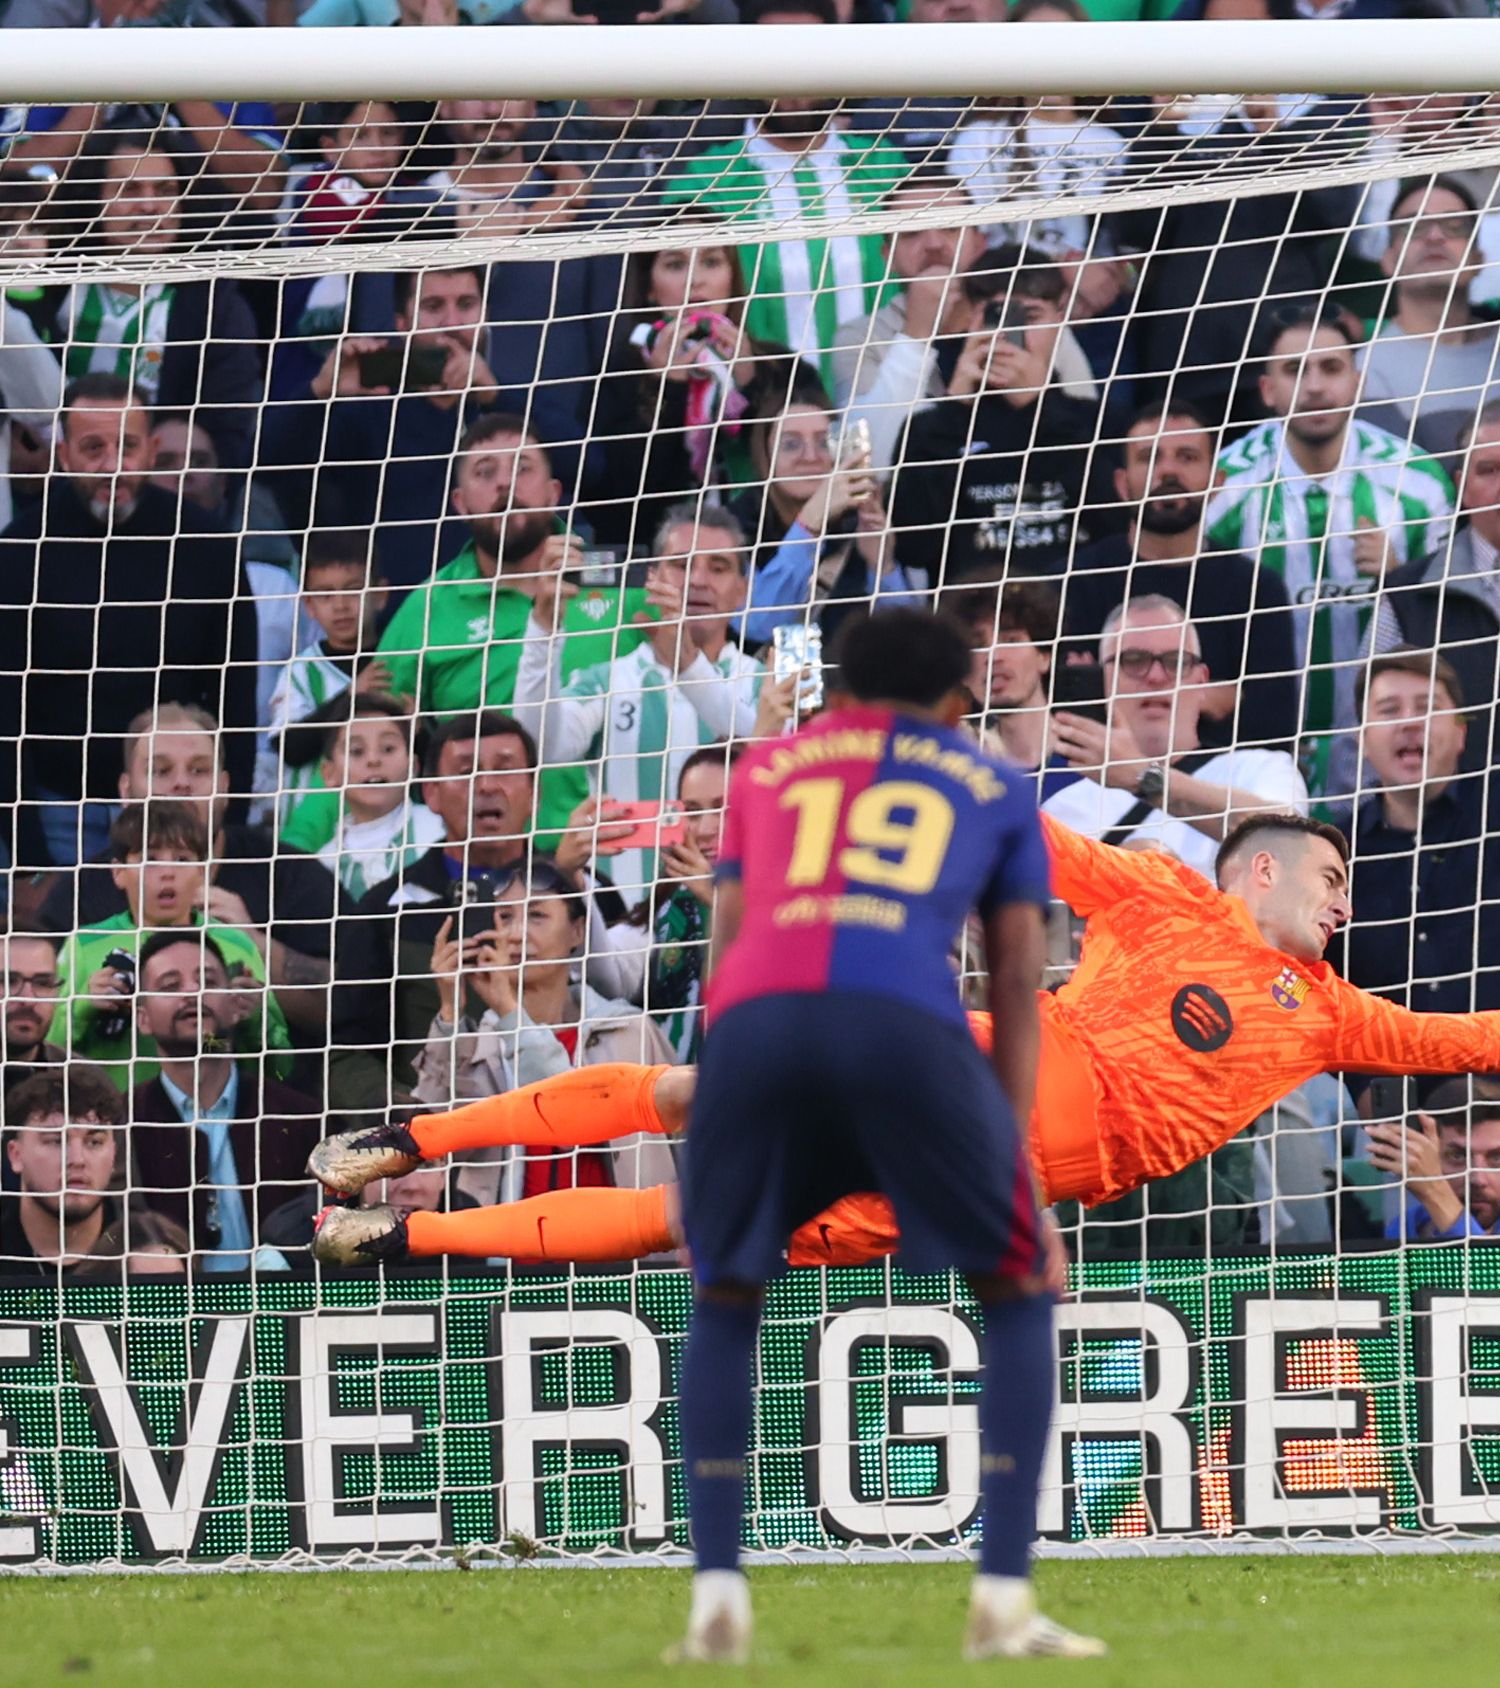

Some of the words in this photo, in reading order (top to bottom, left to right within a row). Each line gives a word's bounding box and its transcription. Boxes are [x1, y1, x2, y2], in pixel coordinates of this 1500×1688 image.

[615, 700, 636, 732] 3
[778, 776, 956, 895] 19
[0, 1308, 666, 1557] VER
